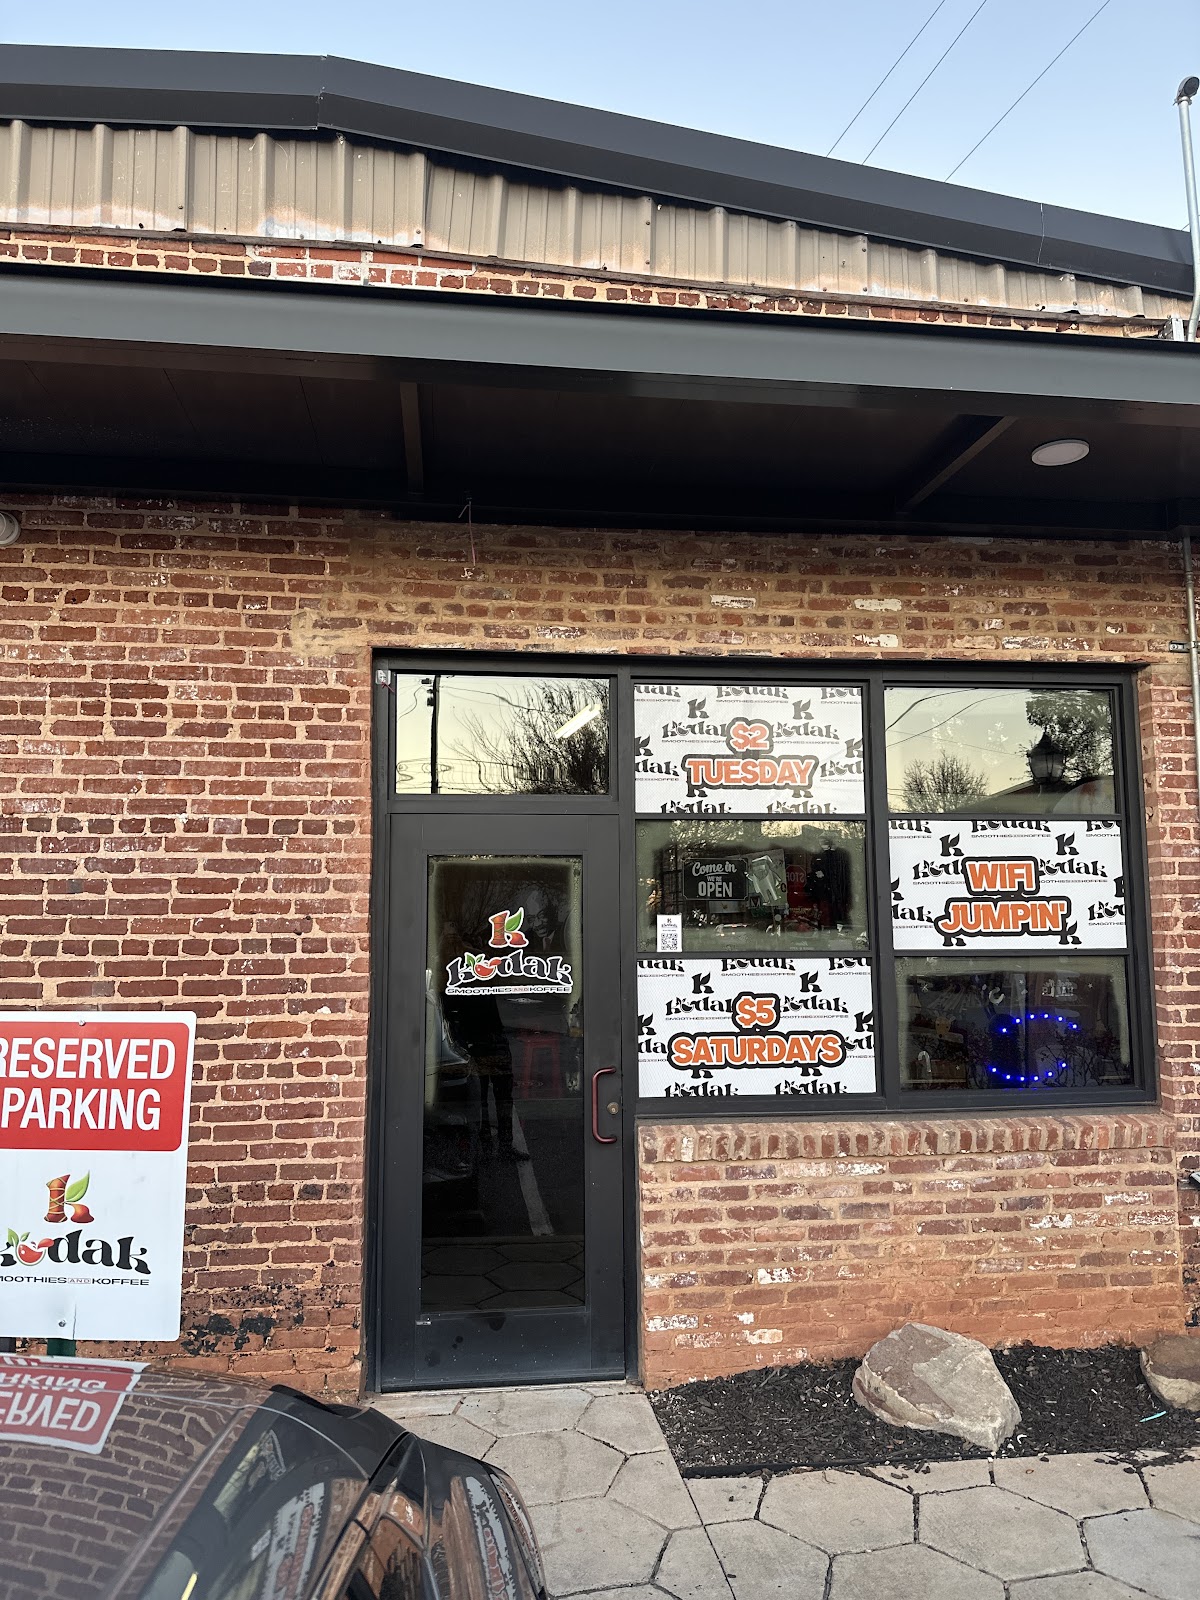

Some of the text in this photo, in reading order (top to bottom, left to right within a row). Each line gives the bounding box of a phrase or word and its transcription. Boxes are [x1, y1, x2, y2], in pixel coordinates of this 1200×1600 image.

[732, 723, 768, 750] $2
[687, 760, 813, 784] TUESDAY
[692, 861, 737, 876] Come in
[968, 863, 1033, 889] WIFI
[698, 881, 732, 897] OPEN
[941, 902, 1065, 930] JUMPIN'
[737, 997, 776, 1027] $5
[673, 1036, 840, 1064] SATURDAYS
[1, 1087, 161, 1130] PARKING
